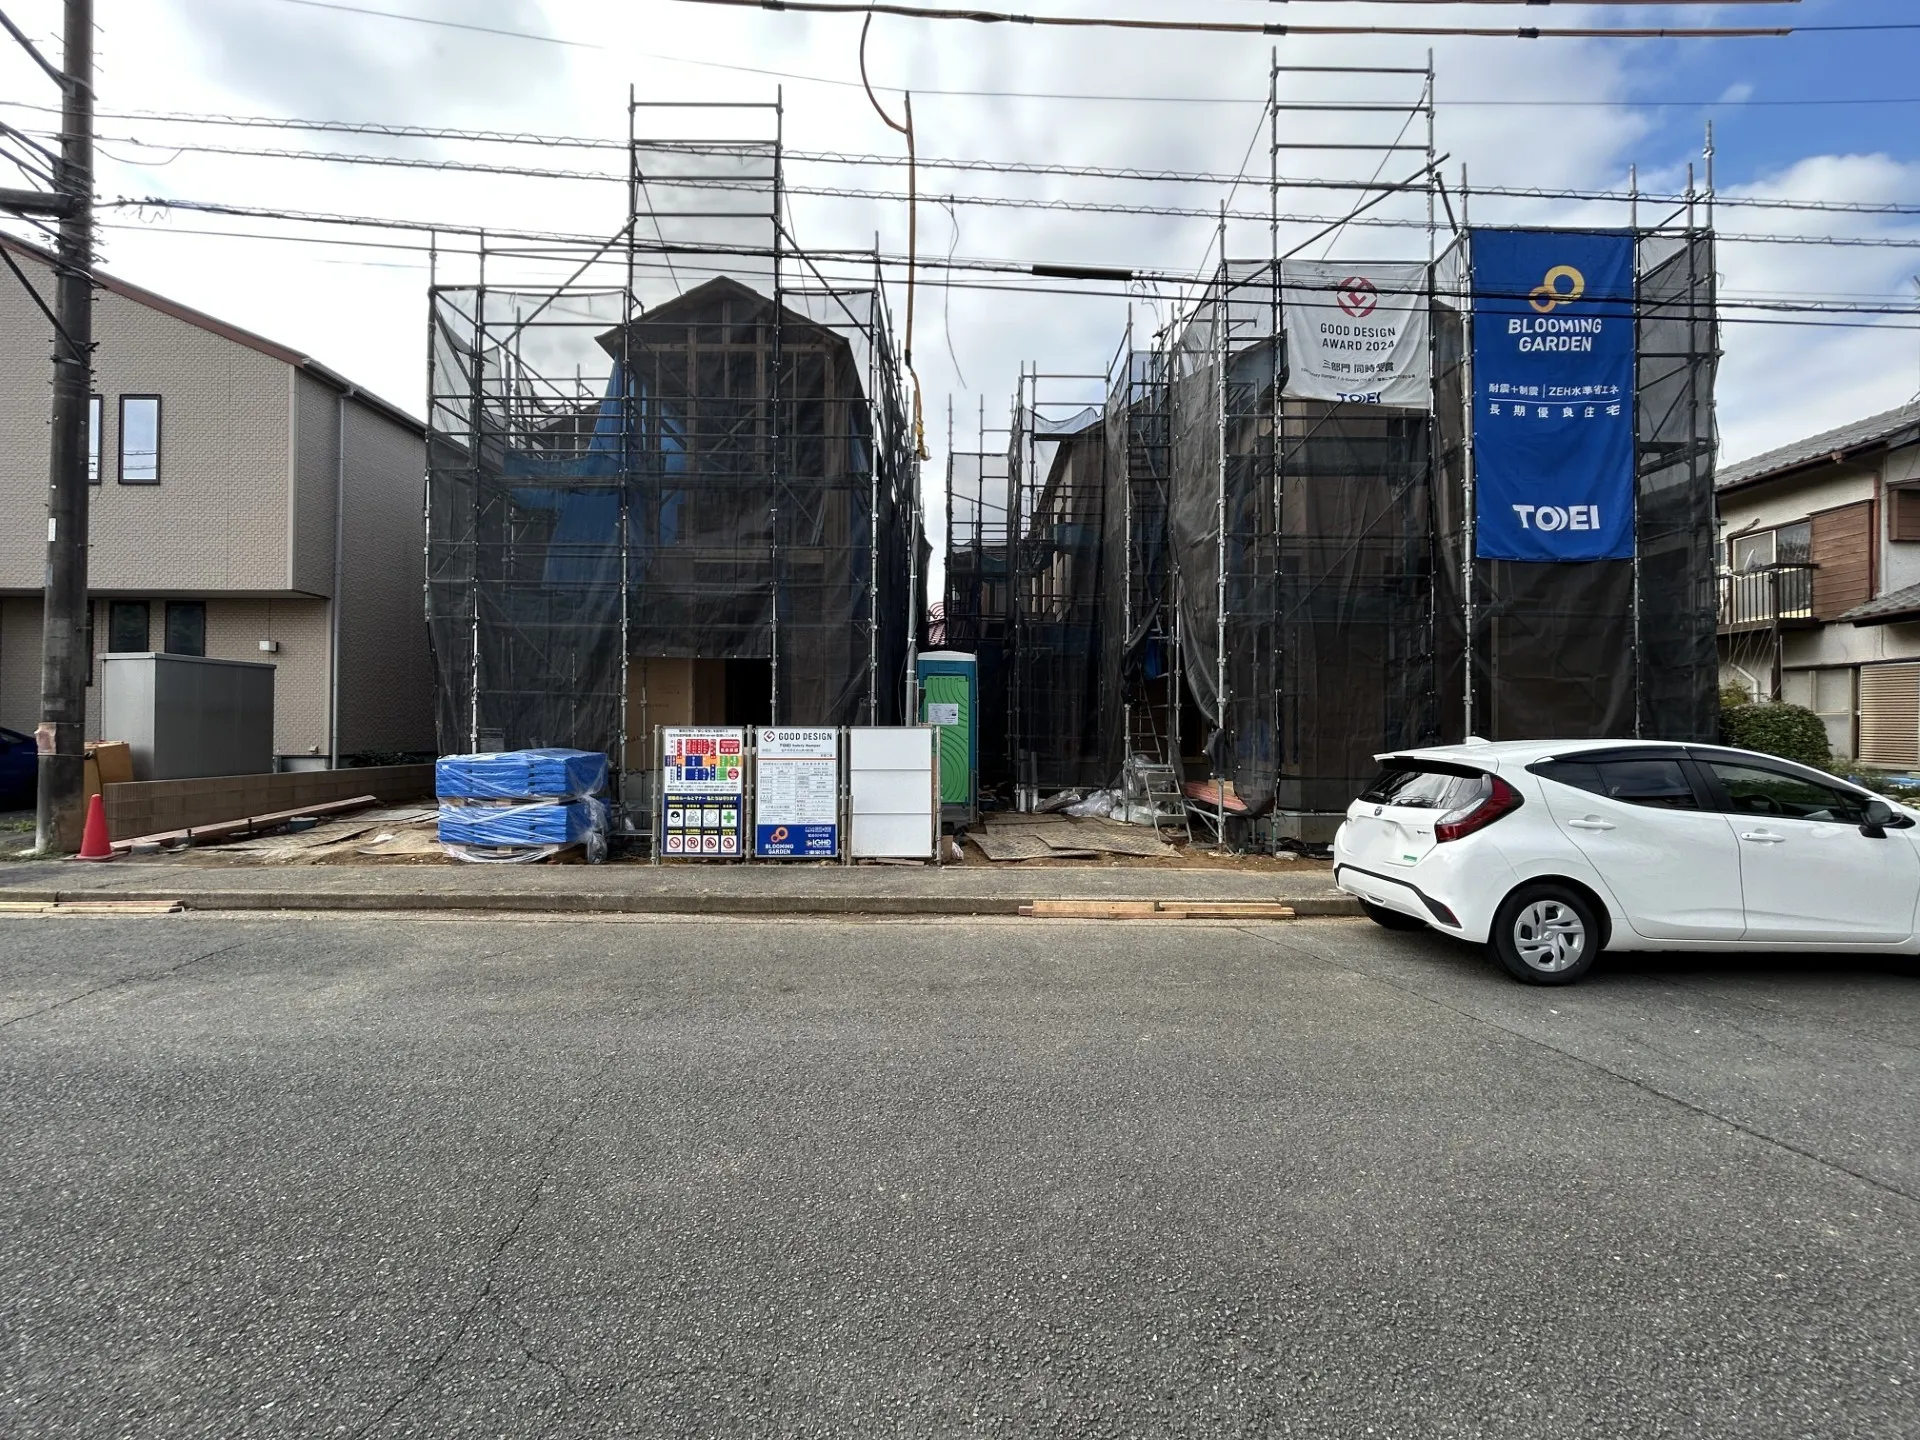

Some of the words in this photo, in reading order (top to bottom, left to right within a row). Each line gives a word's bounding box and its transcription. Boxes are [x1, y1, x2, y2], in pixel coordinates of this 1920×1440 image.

[1320, 323, 1350, 336] GOOD
[1354, 326, 1396, 338] DESIGN
[1508, 318, 1602, 334] BLOOMING
[1322, 338, 1362, 351] AWARD
[1366, 340, 1395, 351] 2024
[1519, 336, 1592, 352] GARDEN
[1322, 359, 1351, 374] 三部門
[1354, 361, 1395, 374] 同時受賞
[1336, 392, 1382, 404] TOEI
[1549, 384, 1620, 397] ZEH水準省エネ
[1489, 403, 1620, 418] 長期優良住宅
[1512, 504, 1600, 531] TOEI
[778, 732, 801, 741] GOOD
[803, 732, 833, 741] DESIGN
